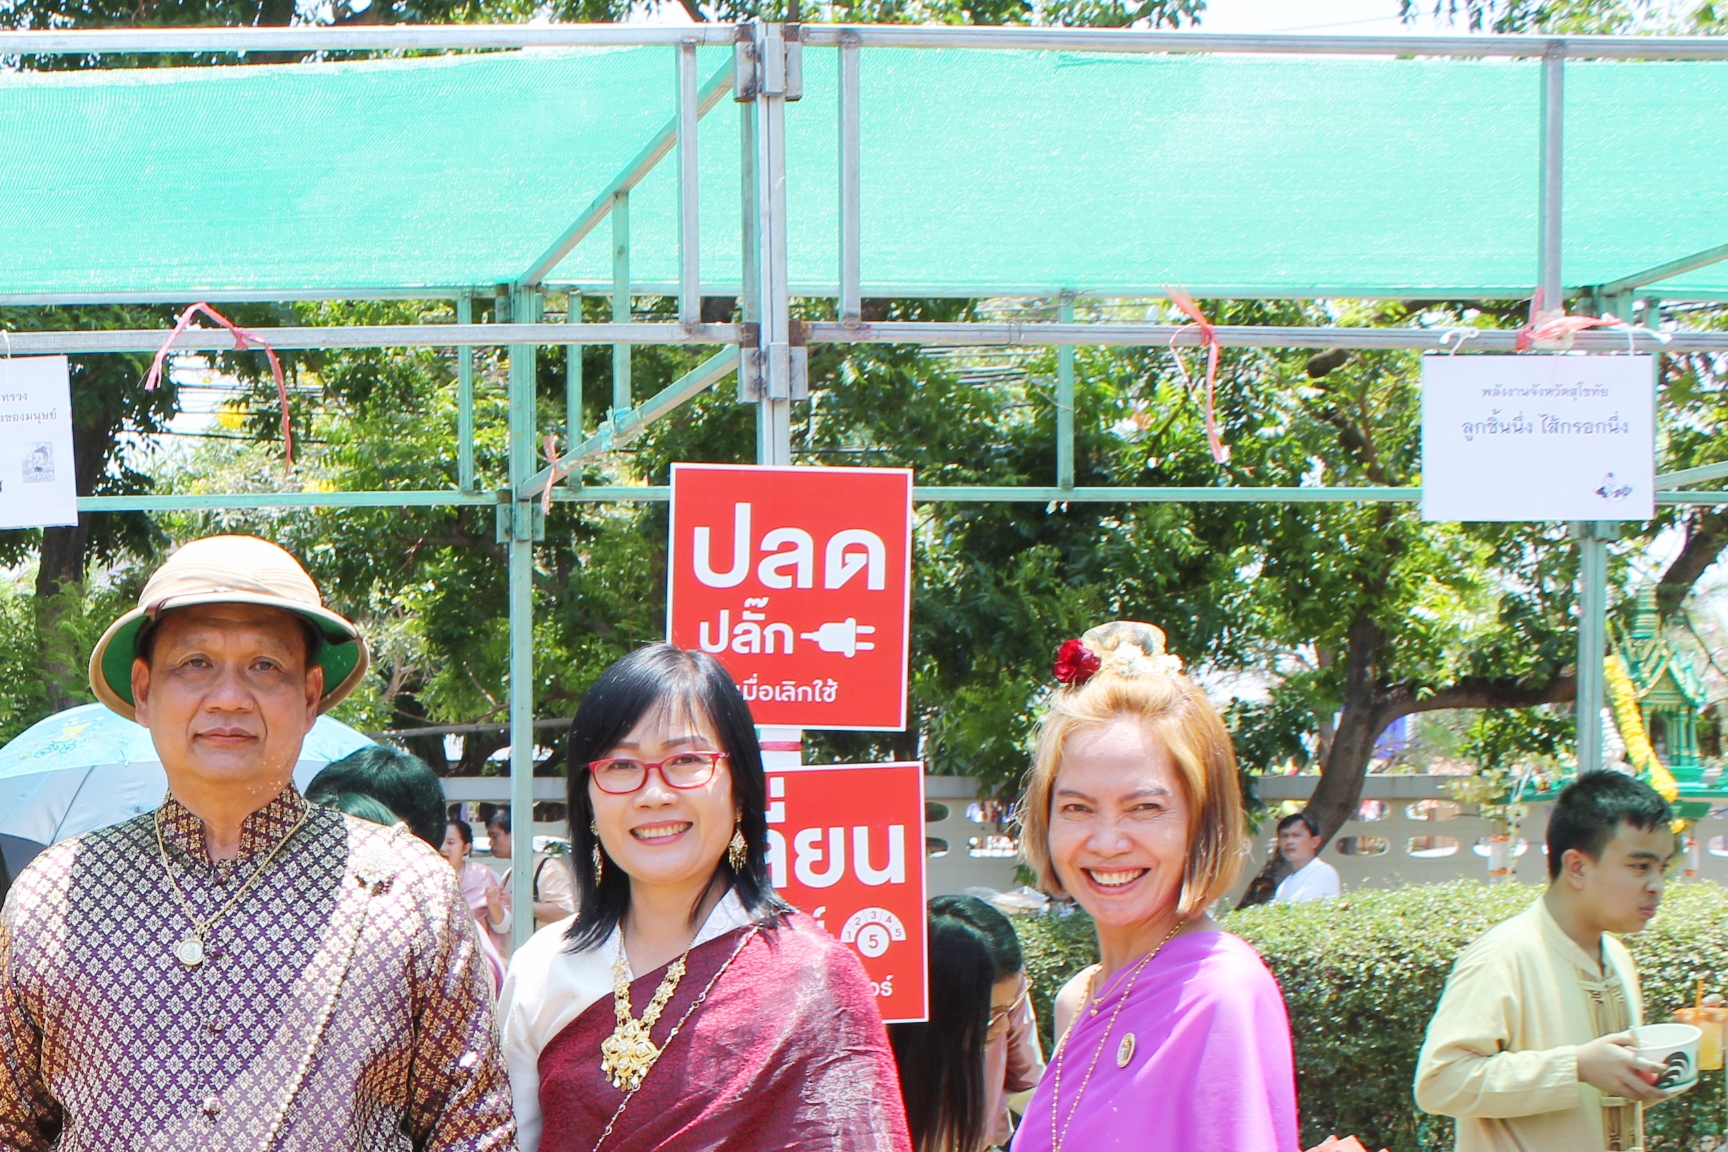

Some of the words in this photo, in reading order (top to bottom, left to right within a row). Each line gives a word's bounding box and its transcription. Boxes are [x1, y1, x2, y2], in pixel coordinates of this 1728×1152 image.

[693, 502, 886, 591] ปลด
[699, 597, 794, 655] ปลั๊ก
[736, 673, 838, 703] มื่อเลิกใช้
